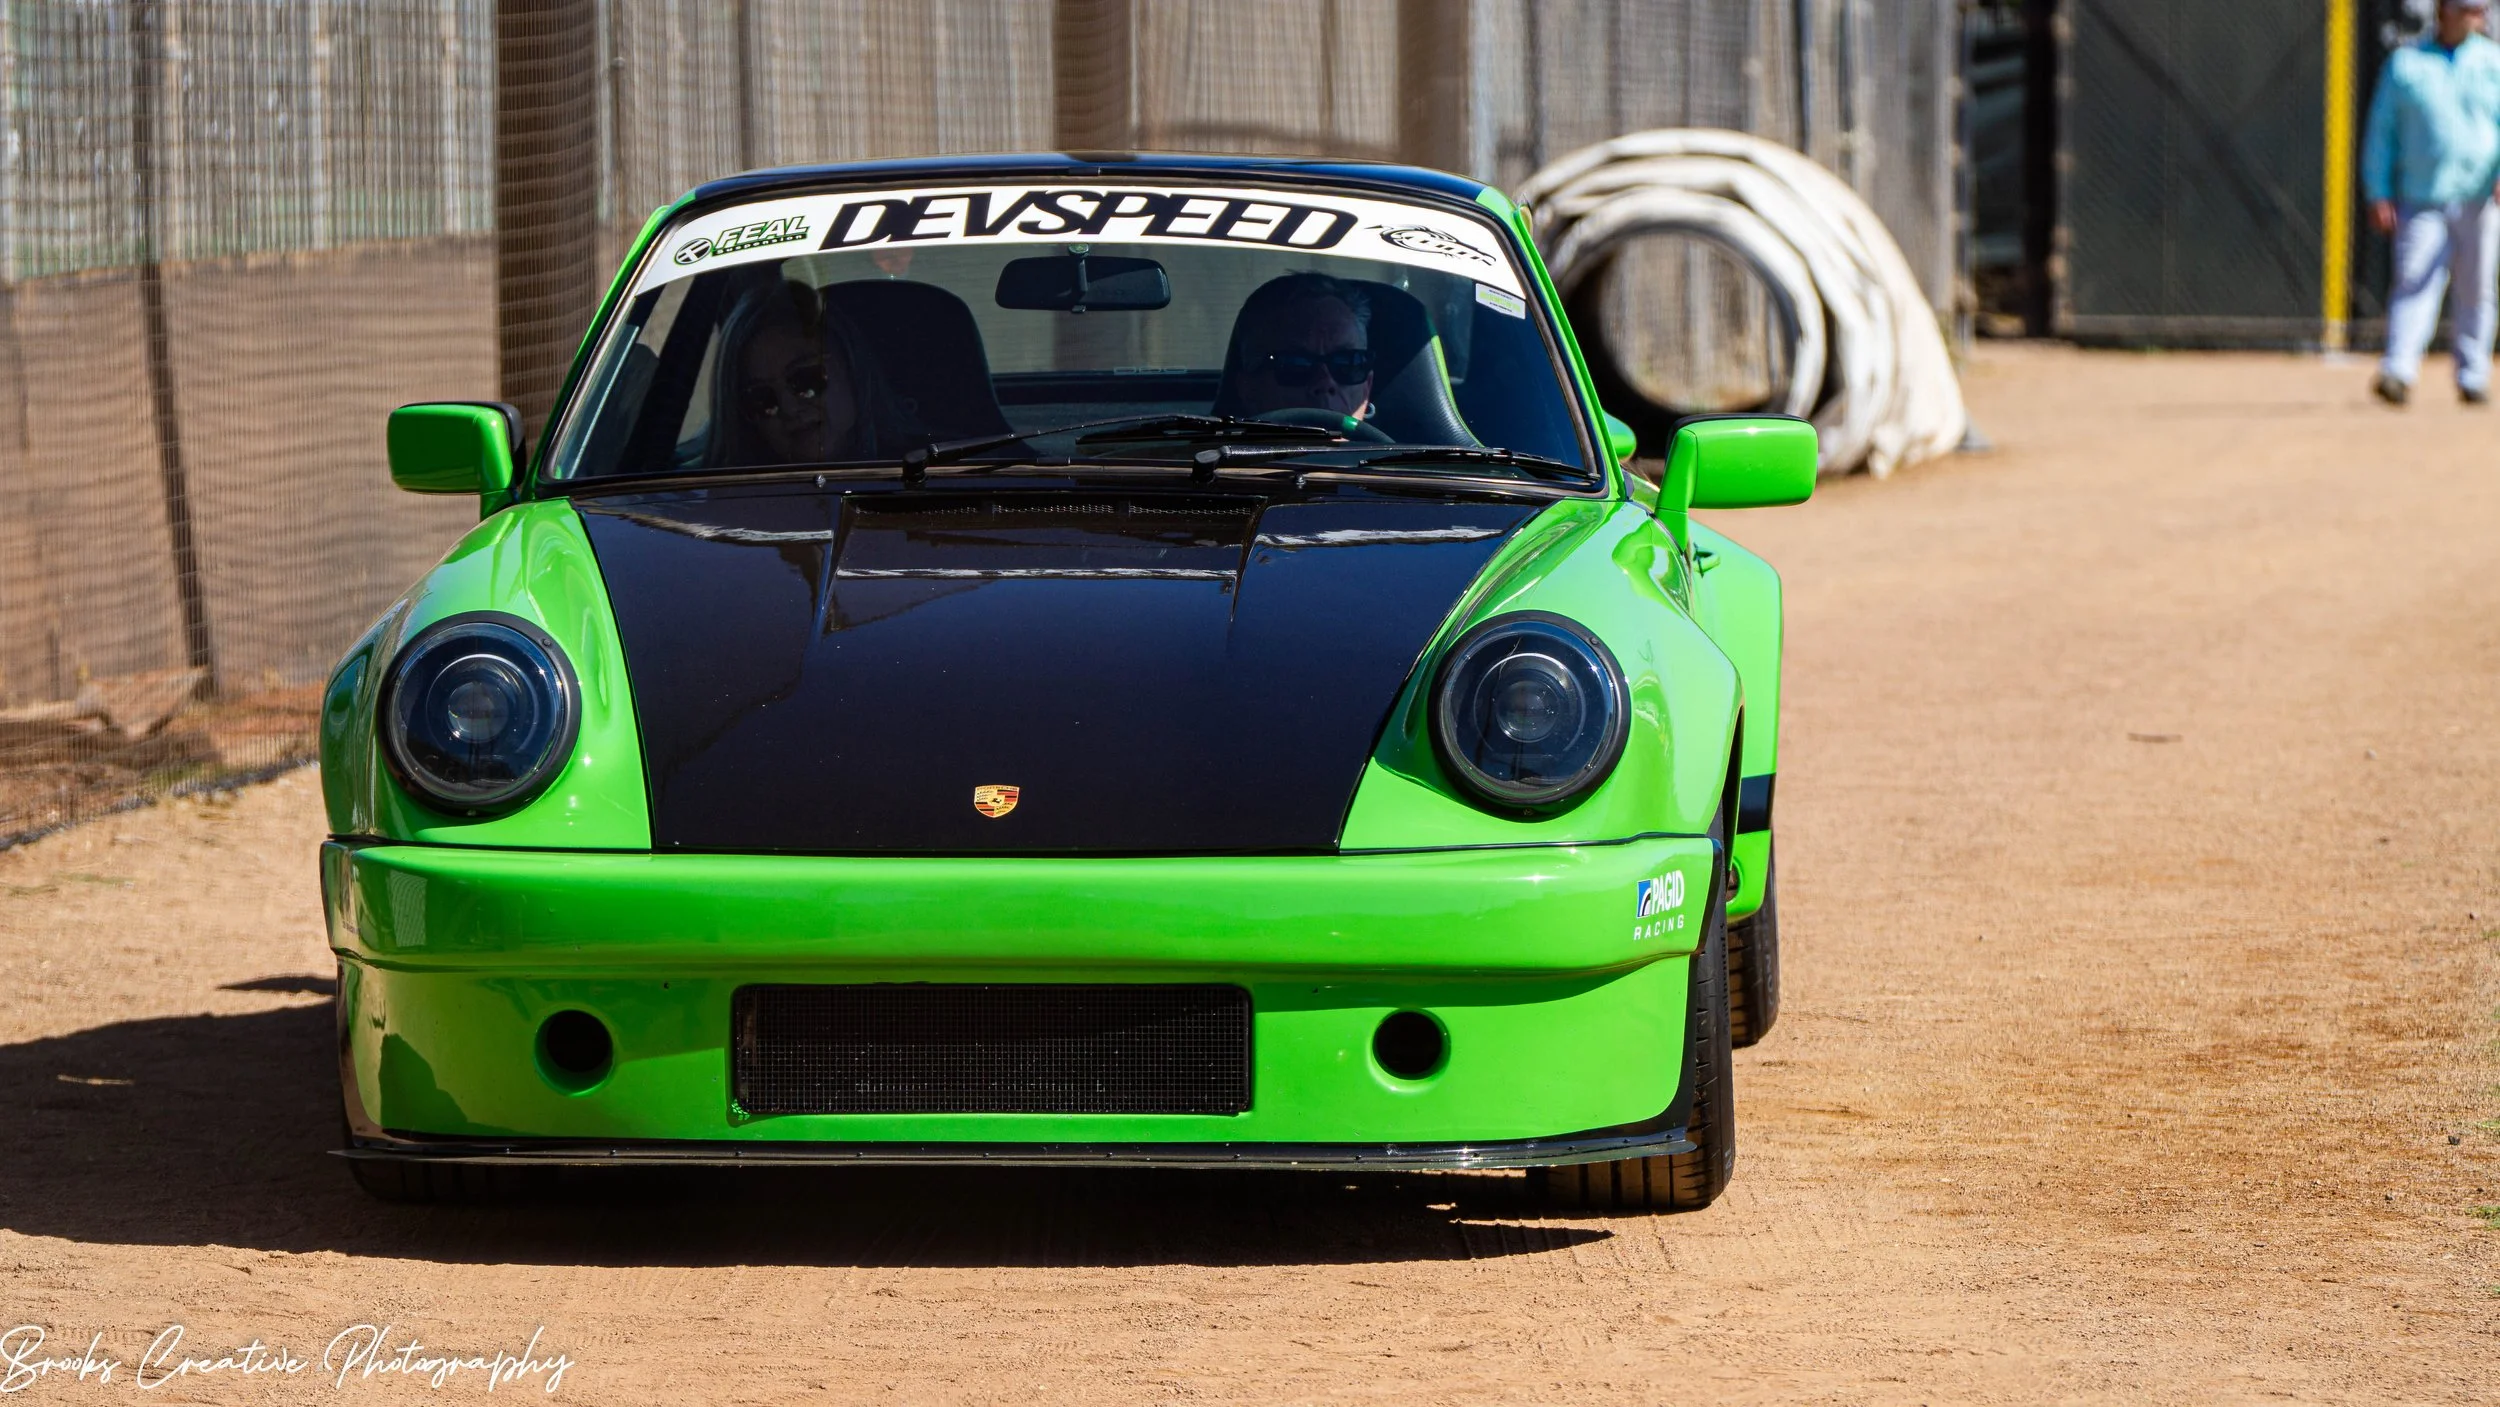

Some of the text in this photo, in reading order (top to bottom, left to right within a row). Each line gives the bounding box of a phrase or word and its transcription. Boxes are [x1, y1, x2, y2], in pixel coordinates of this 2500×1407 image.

[714, 215, 810, 248] FEAL
[818, 189, 1358, 250] DEVSPEED
[1652, 869, 1684, 915] PAGID
[1633, 914, 1684, 940] RACING
